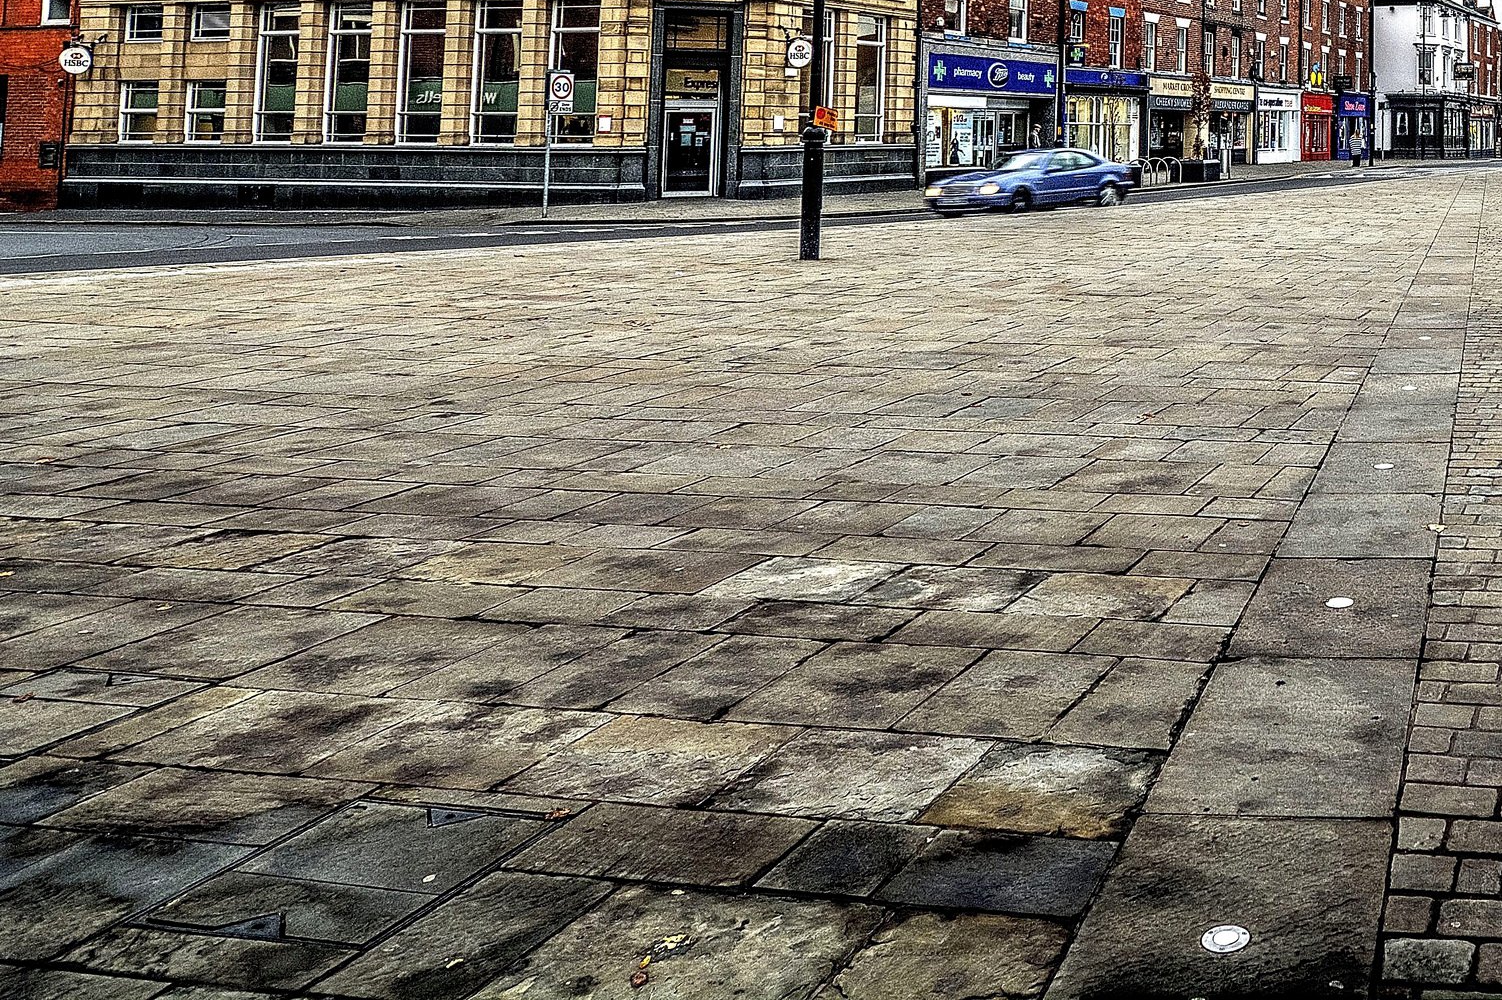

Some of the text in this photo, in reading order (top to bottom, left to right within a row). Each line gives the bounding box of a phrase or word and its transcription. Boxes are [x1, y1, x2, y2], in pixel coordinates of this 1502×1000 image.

[789, 52, 810, 60] HSBC
[63, 59, 89, 67] HSBC
[953, 66, 982, 79] pharmacy
[1017, 71, 1035, 83] beauty
[554, 82, 569, 92] 30
[1162, 81, 1180, 91] MARKET
